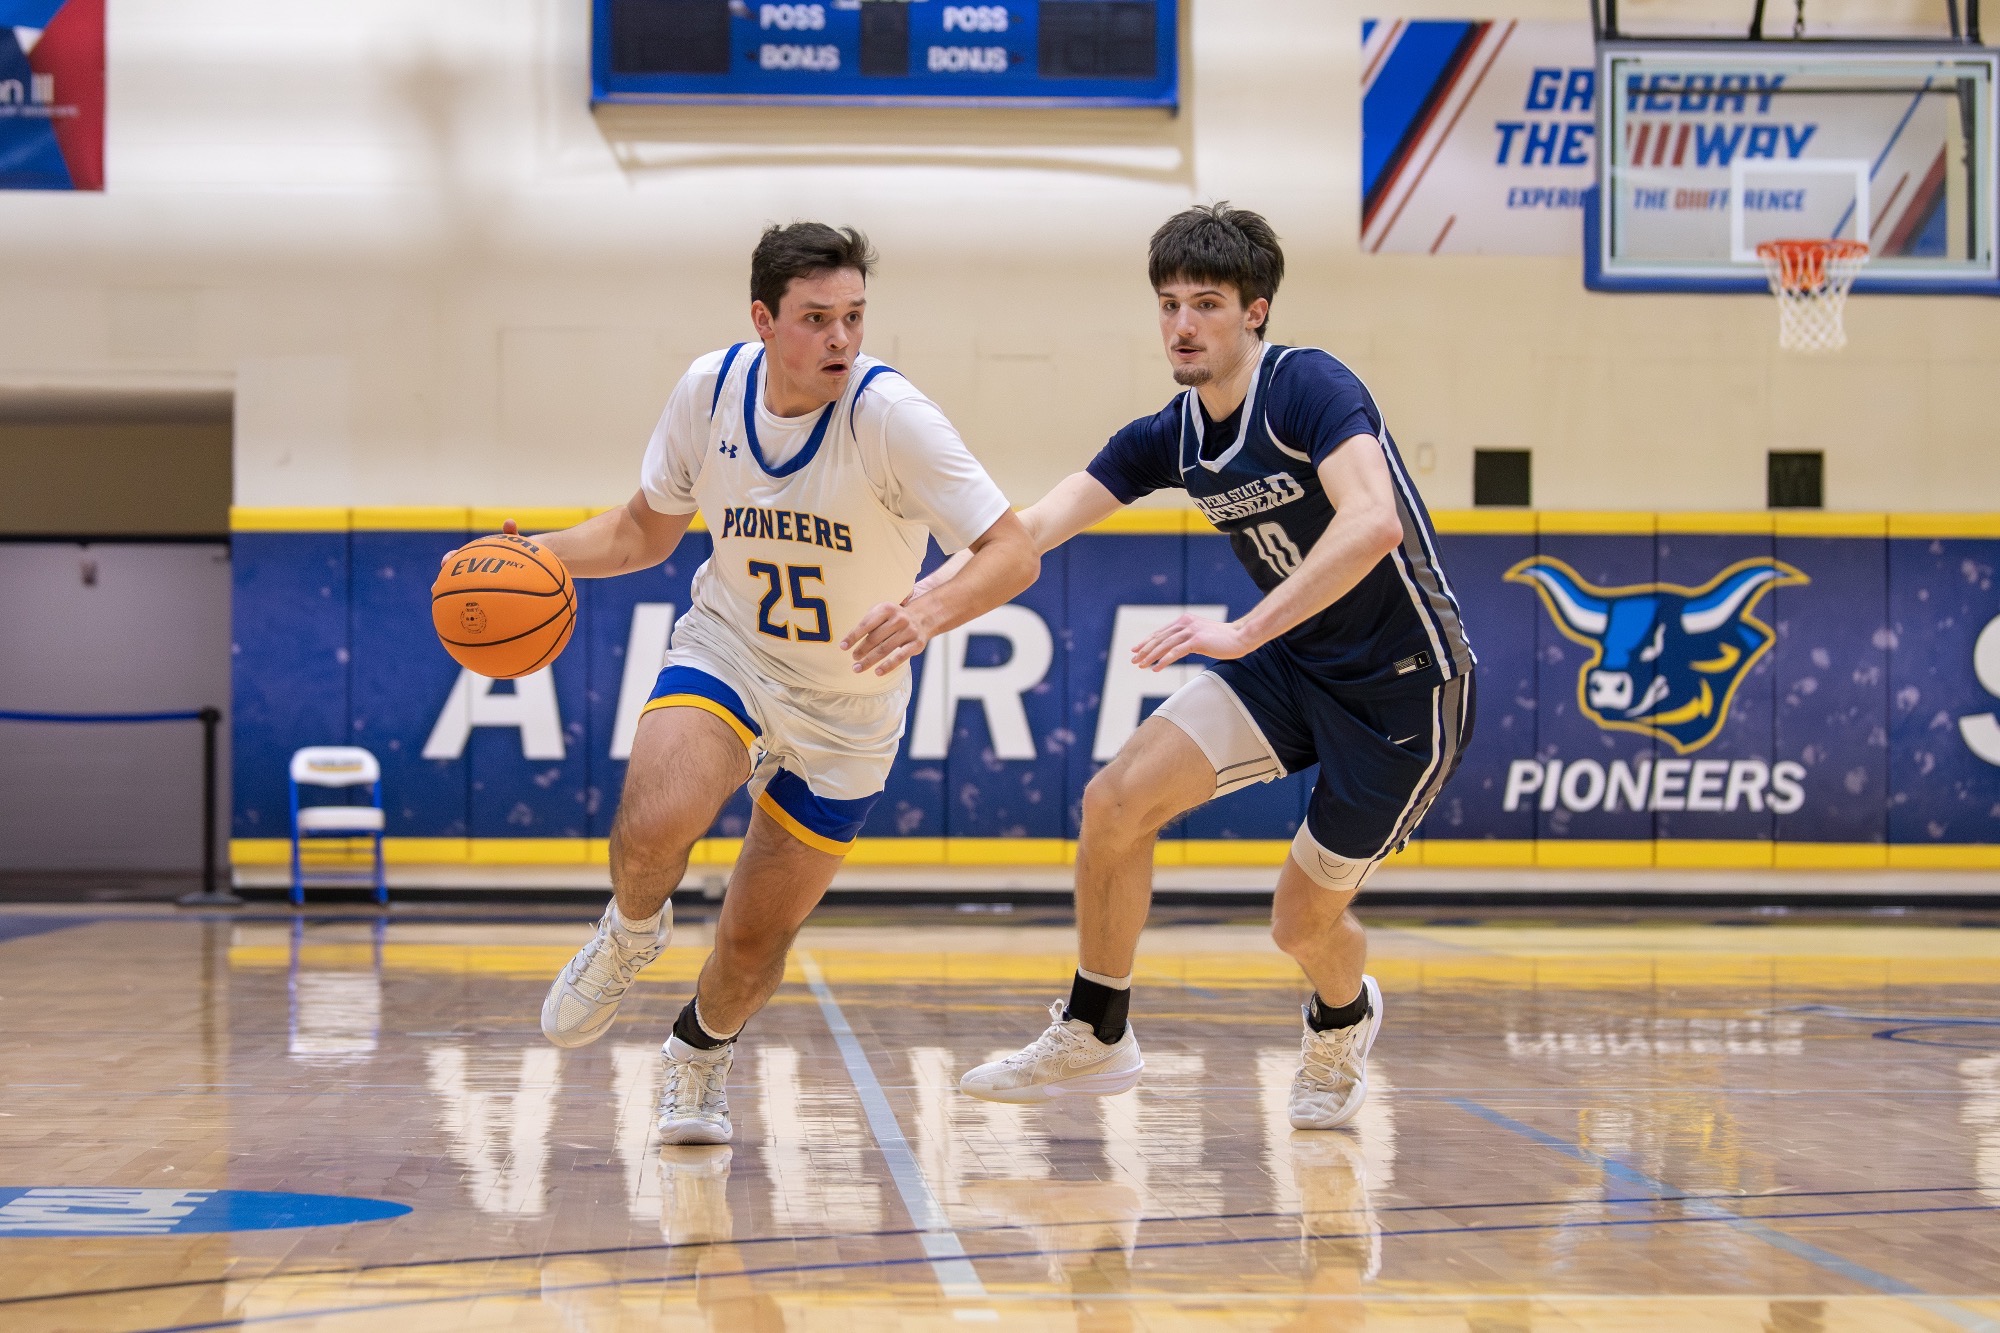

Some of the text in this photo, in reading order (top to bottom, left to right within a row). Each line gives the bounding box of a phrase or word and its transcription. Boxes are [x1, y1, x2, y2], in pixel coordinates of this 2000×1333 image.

[760, 4, 825, 31] POSS
[942, 6, 1008, 33] POSS
[760, 44, 841, 71] BONUS
[928, 46, 1008, 73] BONUS
[1524, 67, 1786, 113] GAEDAY
[1495, 121, 1595, 166] THE
[1634, 187, 1669, 210] THE
[1202, 480, 1265, 507] PENN STATE
[721, 507, 853, 552] PIONEERS
[1242, 522, 1303, 579] 10
[747, 558, 833, 643] 25
[1502, 758, 1807, 815] PIONEERS
